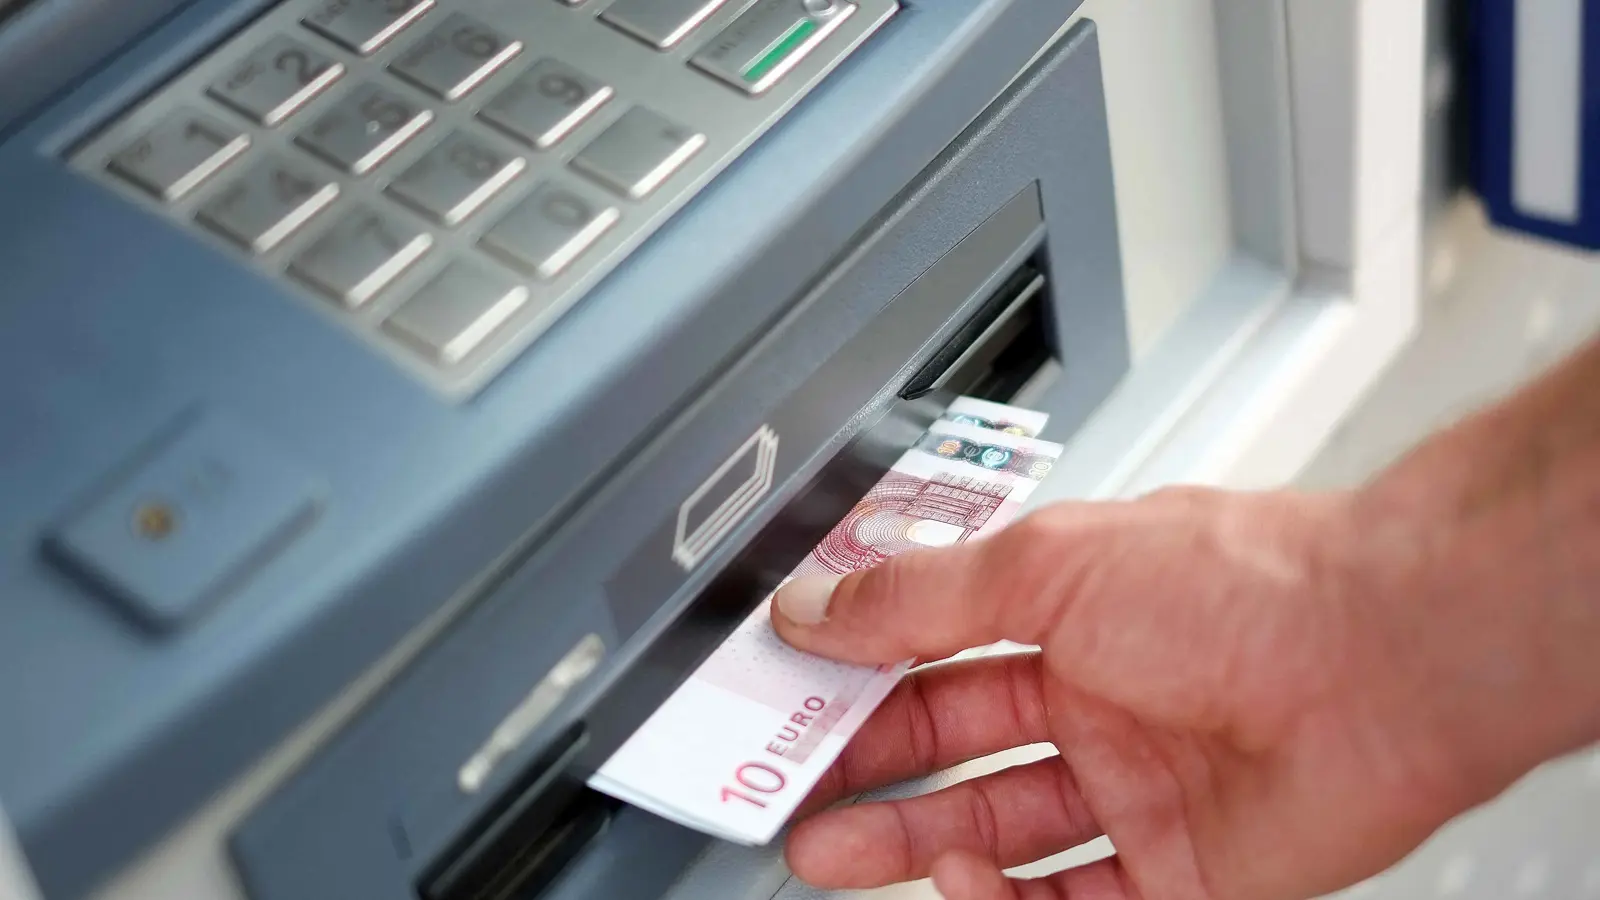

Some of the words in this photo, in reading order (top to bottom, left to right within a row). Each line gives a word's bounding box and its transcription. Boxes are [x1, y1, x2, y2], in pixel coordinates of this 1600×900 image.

[450, 25, 499, 58] 6
[273, 48, 331, 86] 2
[538, 73, 587, 105] 9
[358, 93, 412, 132] 5
[183, 121, 235, 148] 1
[719, 760, 789, 810] 10
[765, 695, 827, 757] EURO
